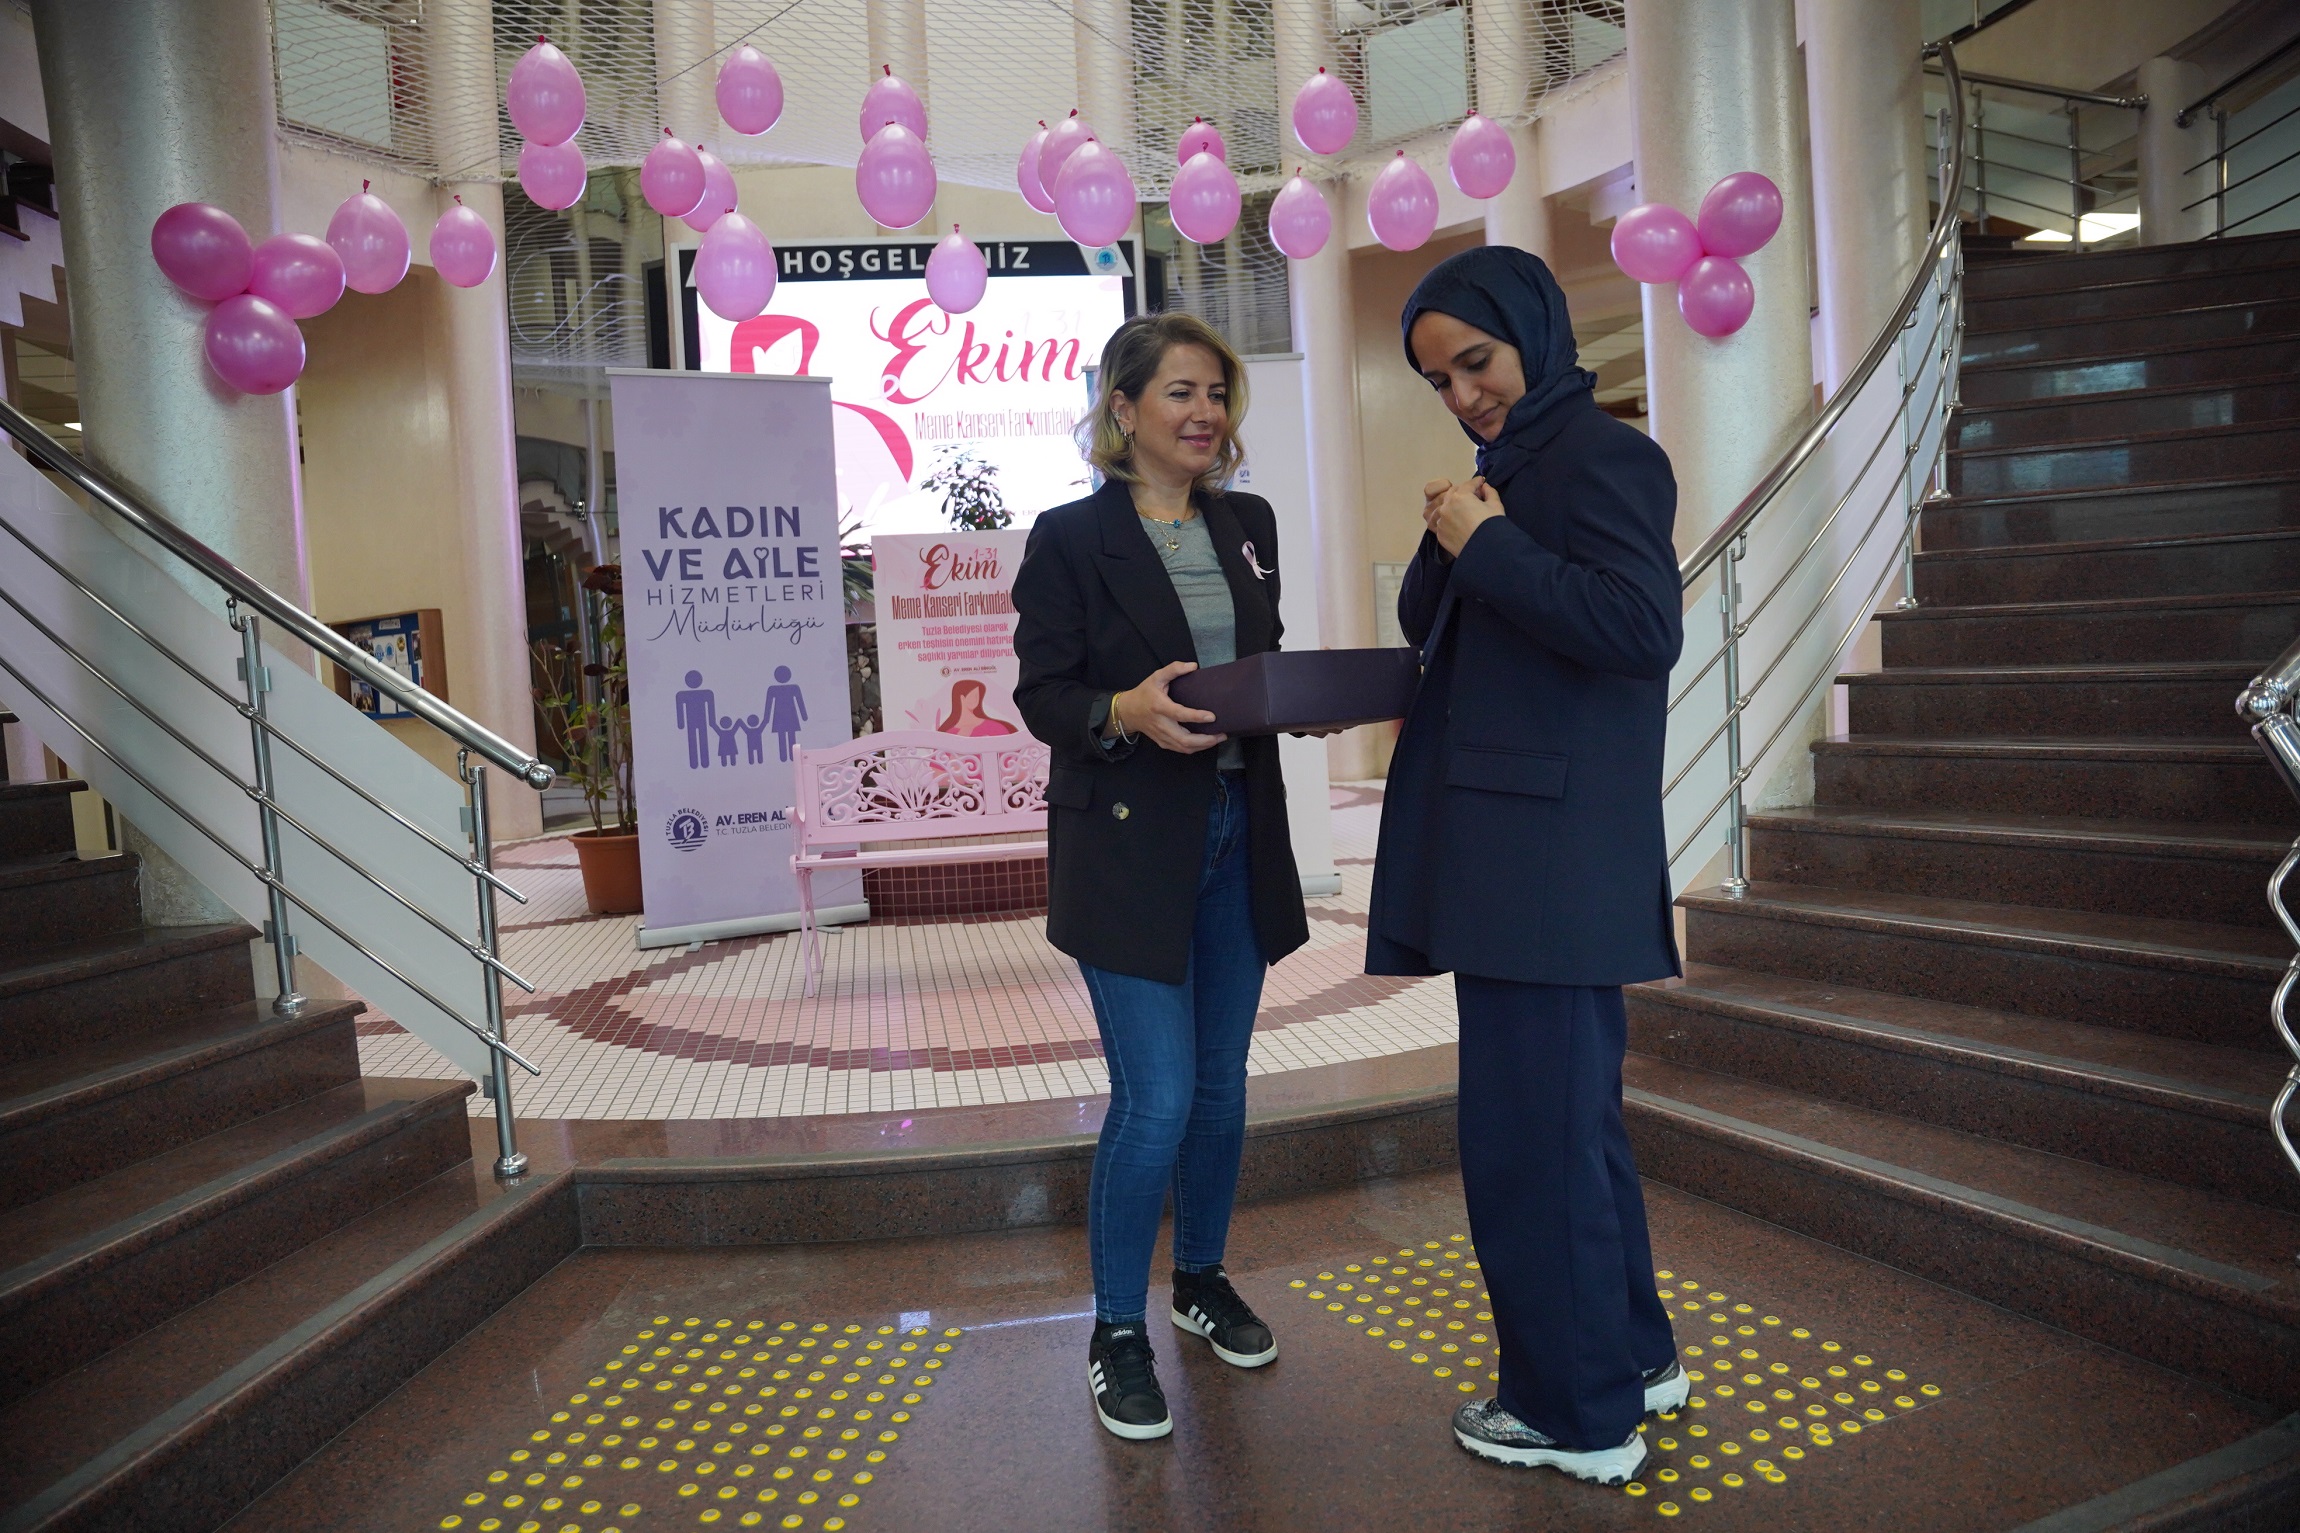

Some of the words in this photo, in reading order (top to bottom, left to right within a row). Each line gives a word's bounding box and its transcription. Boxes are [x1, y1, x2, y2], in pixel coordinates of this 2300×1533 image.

[783, 242, 1030, 280] HOŞGELİZ
[870, 297, 1094, 405] Ekim
[914, 411, 953, 440] Meme
[956, 407, 1006, 439] Kanseri
[659, 506, 800, 539] KADIN
[641, 548, 704, 581] VE
[919, 543, 1003, 590] Ekim
[974, 547, 998, 560] 1-31
[647, 580, 824, 605] HİZMETLERİ
[891, 595, 922, 620] Meme
[923, 592, 962, 618] Kanseri
[646, 604, 825, 645] Müdürlüğü
[921, 626, 942, 636] Tuzla
[943, 623, 982, 635] Belediyesi
[983, 622, 1009, 633] olarak
[898, 641, 921, 650] erken
[986, 635, 1014, 645] hatırla
[665, 813, 678, 836] TUZLA
[715, 815, 735, 827] AV.
[737, 811, 768, 825] EREN
[770, 805, 788, 822] AL
[731, 825, 757, 834] TUZLA
[759, 822, 793, 832] BELEDİY
[1111, 1328, 1134, 1338] adidas
